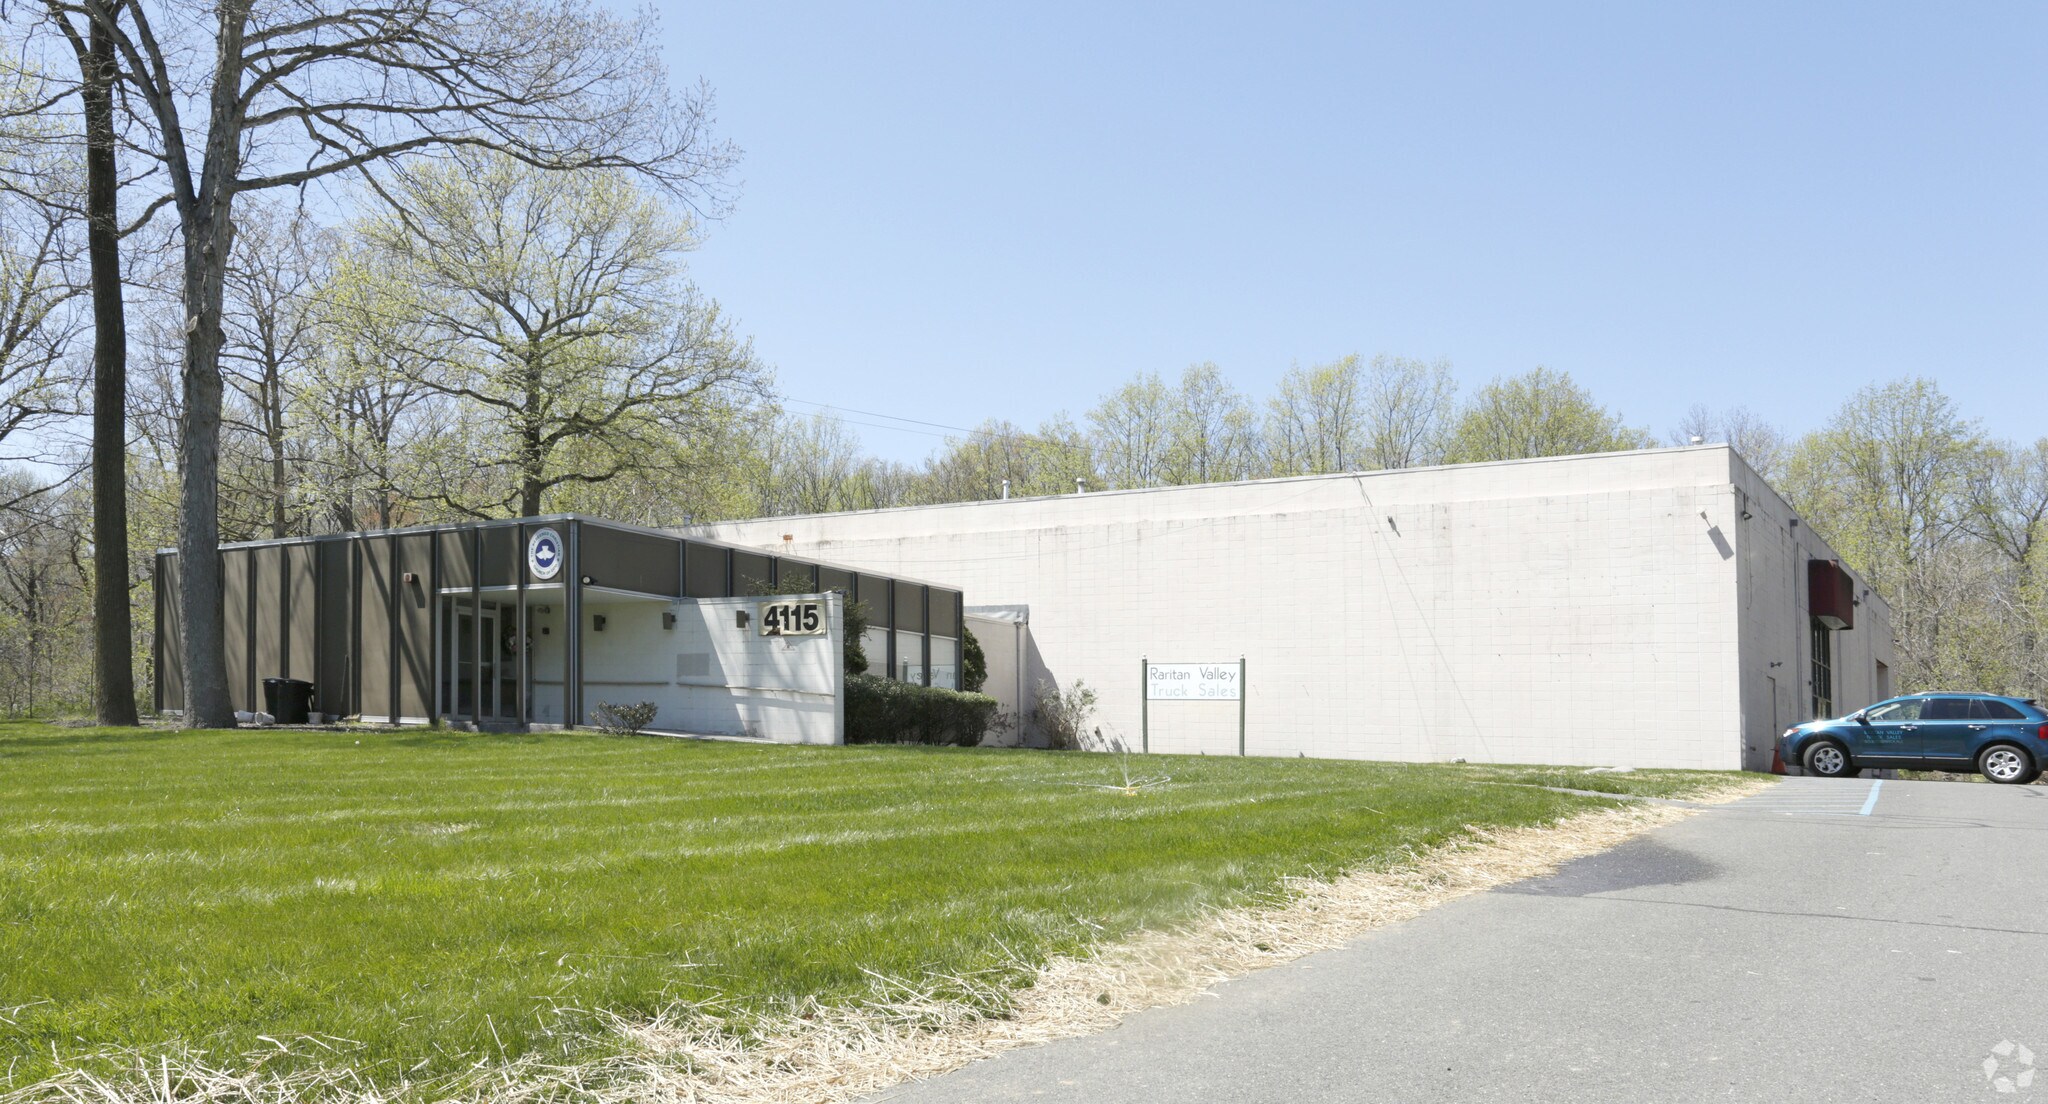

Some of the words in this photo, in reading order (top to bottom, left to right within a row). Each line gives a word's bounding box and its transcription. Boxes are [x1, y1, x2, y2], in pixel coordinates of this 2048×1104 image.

[764, 605, 818, 631] 4115
[1150, 667, 1190, 680] Raritan
[1199, 667, 1236, 682] Valley
[1151, 683, 1188, 697] Truck
[1199, 683, 1236, 697] Sales
